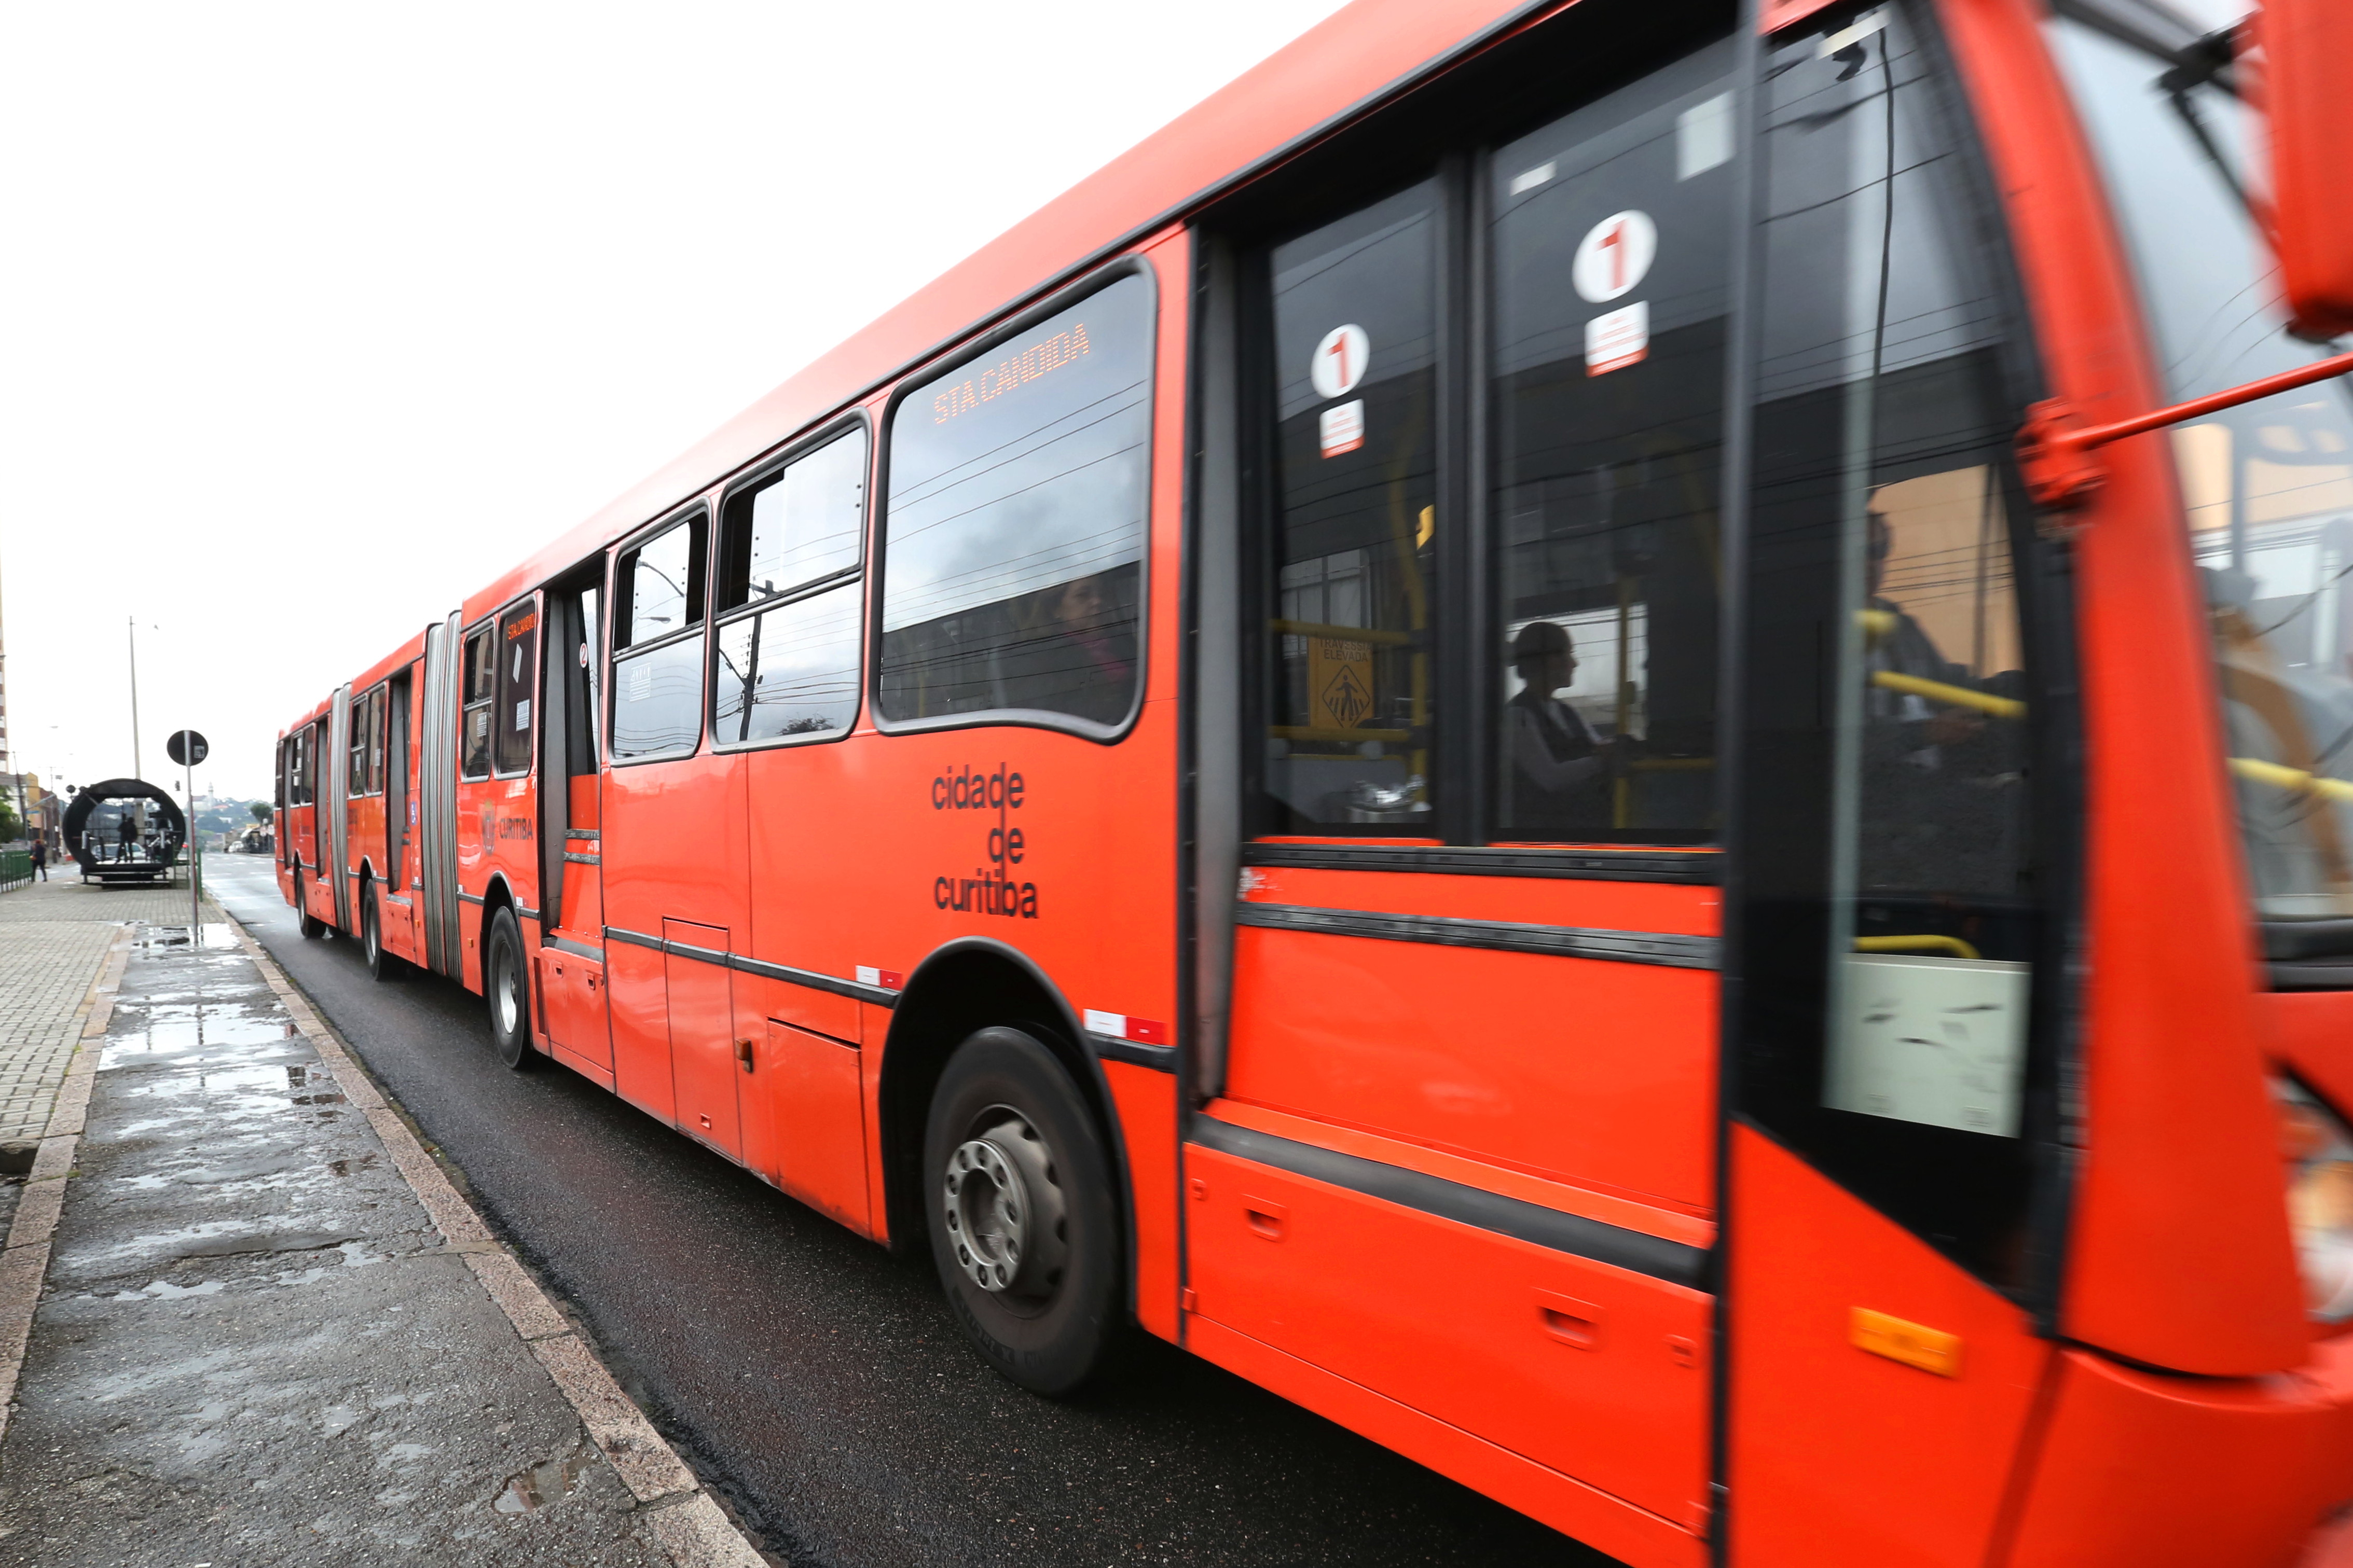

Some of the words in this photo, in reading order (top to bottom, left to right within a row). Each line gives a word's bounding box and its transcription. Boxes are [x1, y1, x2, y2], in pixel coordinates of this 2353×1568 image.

[1594, 216, 1630, 292] 1
[1326, 330, 1352, 389] 1
[581, 644, 586, 664] 2
[1324, 649, 1368, 662] ELEVADA
[932, 762, 1025, 810] cidade
[499, 817, 533, 840] CURITIBA
[988, 814, 1025, 864] de
[935, 867, 1039, 919] curitiba
